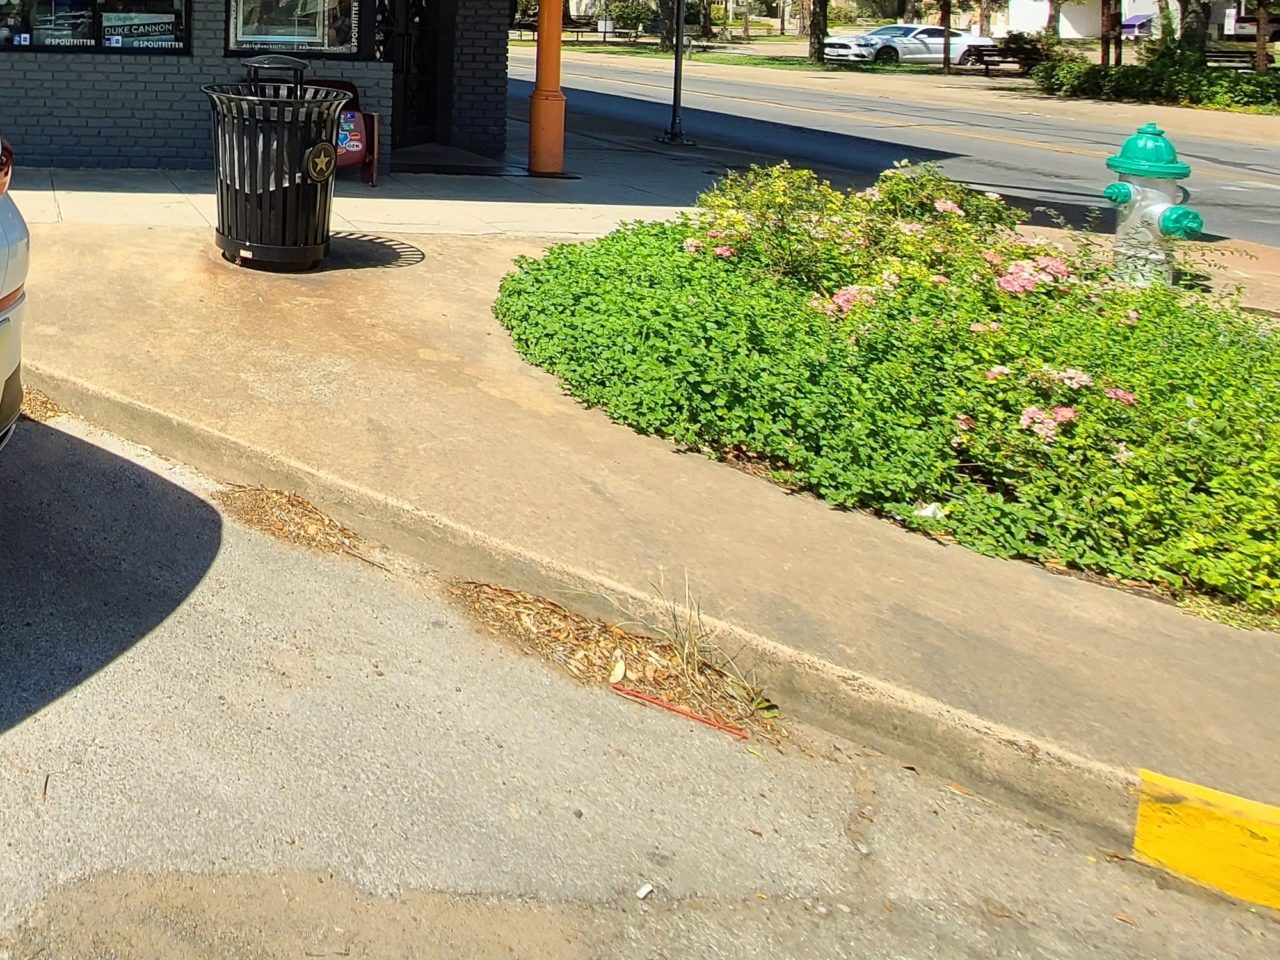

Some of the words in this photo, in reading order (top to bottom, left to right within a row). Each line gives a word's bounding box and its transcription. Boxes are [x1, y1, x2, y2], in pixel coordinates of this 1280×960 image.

[104, 26, 130, 35] DUKE
[131, 23, 172, 34] CANNON
[45, 38, 95, 46] @SPOUTFITTER
[133, 40, 184, 49] @SPOUTFITTER
